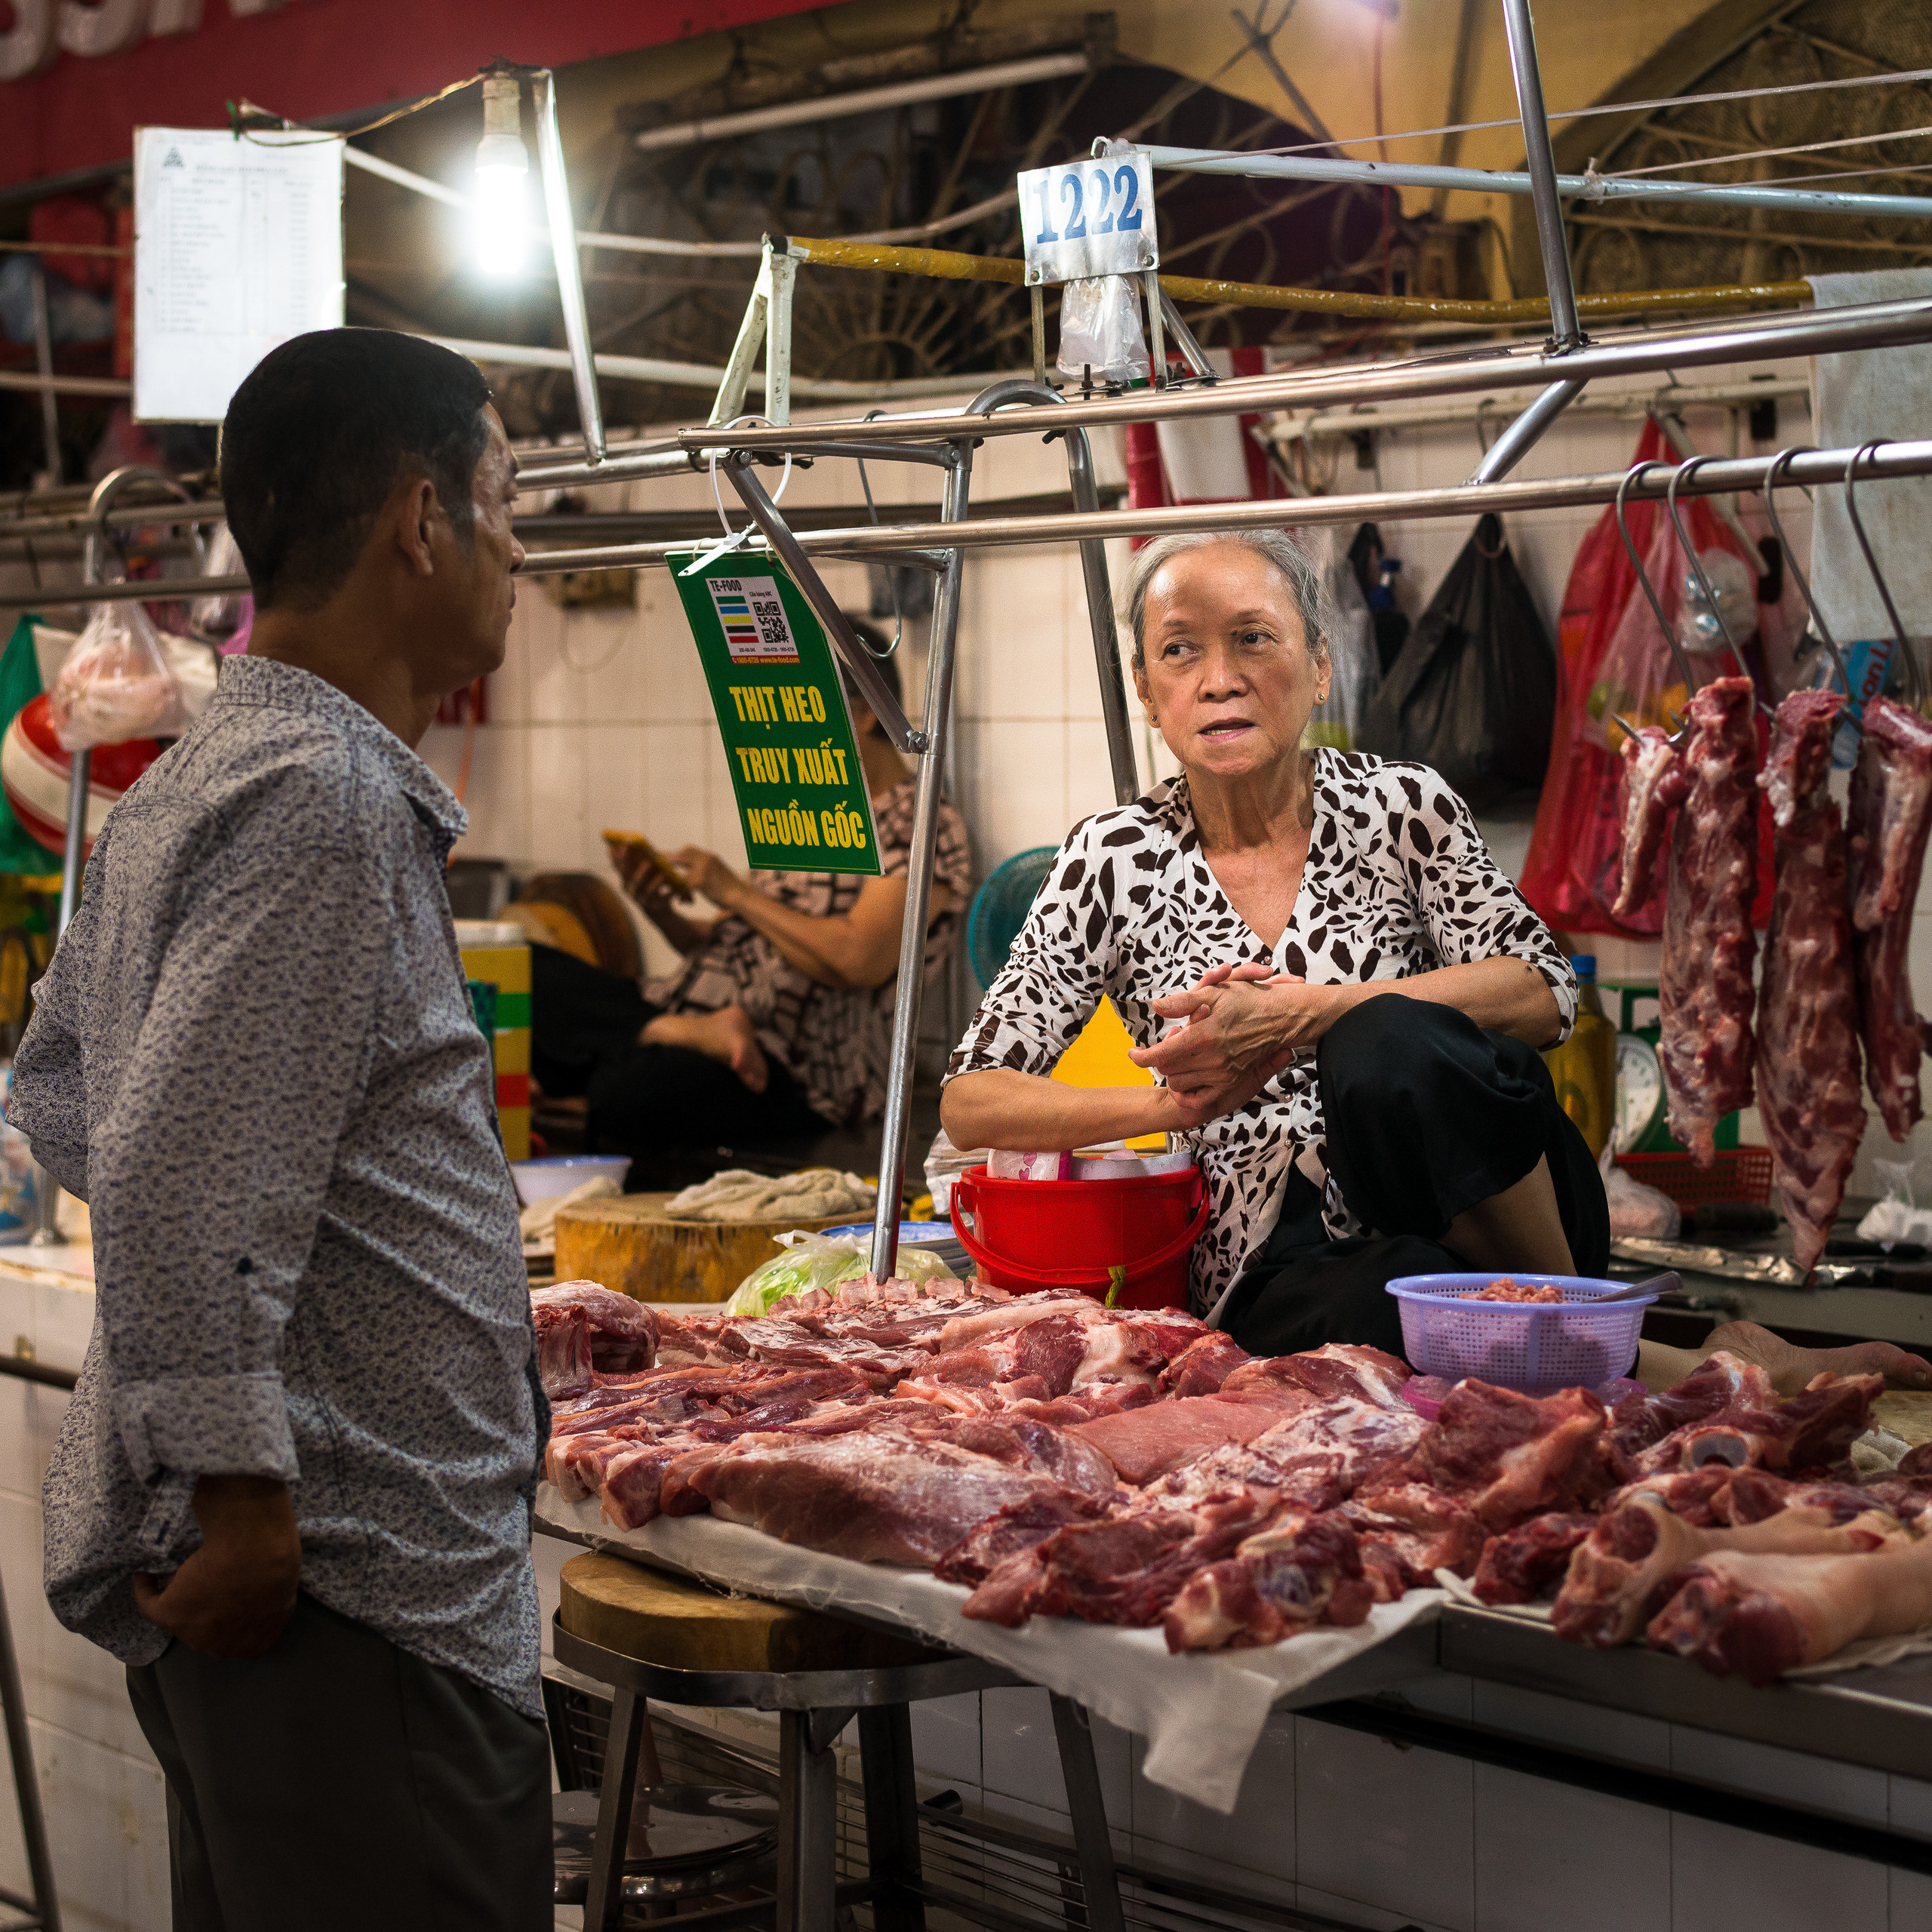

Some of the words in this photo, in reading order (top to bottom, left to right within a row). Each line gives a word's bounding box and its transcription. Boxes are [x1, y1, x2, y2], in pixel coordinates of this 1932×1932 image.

[1033, 165, 1143, 244] 1222
[709, 580, 742, 592] TE-FOOD
[760, 656, 801, 664] www.te-food.com
[728, 686, 779, 730] THỊT
[778, 685, 826, 723] HEO
[735, 747, 791, 784] TRUY
[792, 737, 849, 785] XUẤT
[746, 798, 820, 846] NGUỒN
[820, 801, 866, 849] GỐC
